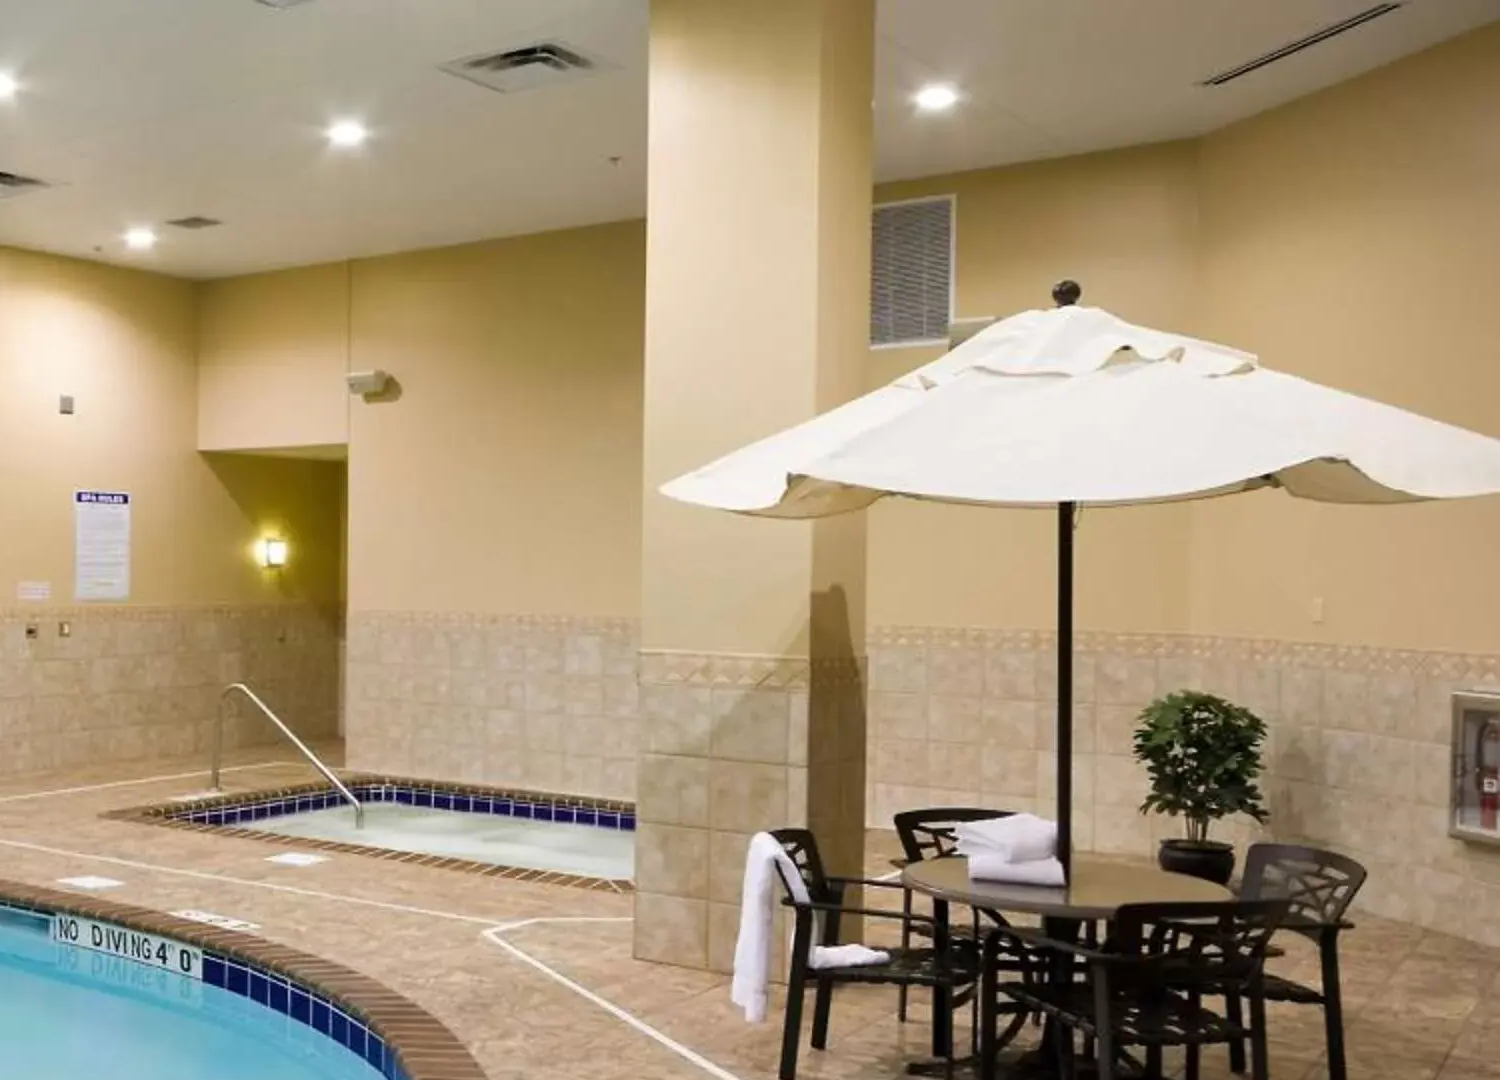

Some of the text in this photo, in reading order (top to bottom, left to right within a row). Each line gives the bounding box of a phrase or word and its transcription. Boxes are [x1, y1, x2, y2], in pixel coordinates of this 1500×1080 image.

[59, 916, 79, 941] NO
[91, 925, 151, 959] DIVING
[156, 942, 168, 965] 4
[179, 949, 191, 972] 0
